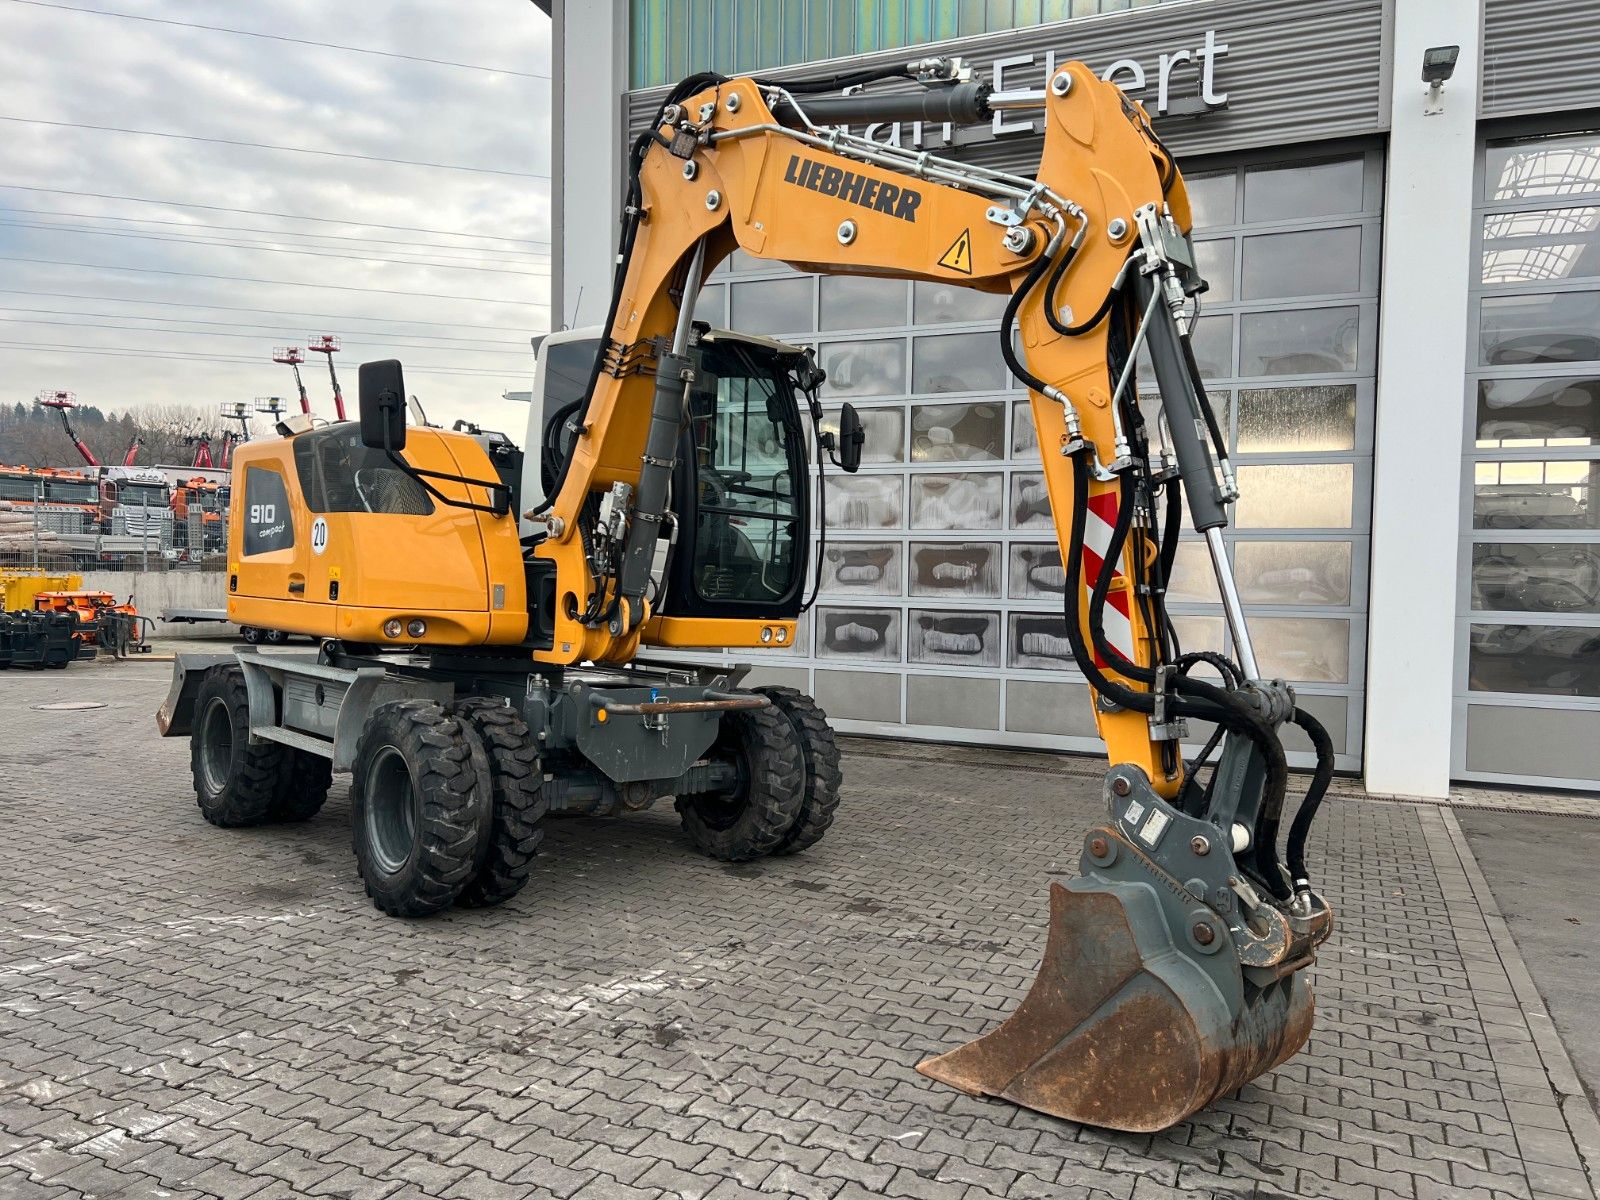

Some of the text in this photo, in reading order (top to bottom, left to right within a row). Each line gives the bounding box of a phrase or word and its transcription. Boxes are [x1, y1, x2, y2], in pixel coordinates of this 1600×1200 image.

[784, 155, 922, 223] LIEBHERR
[250, 504, 276, 524] 910
[259, 520, 286, 538] compact
[314, 522, 326, 546] 20
